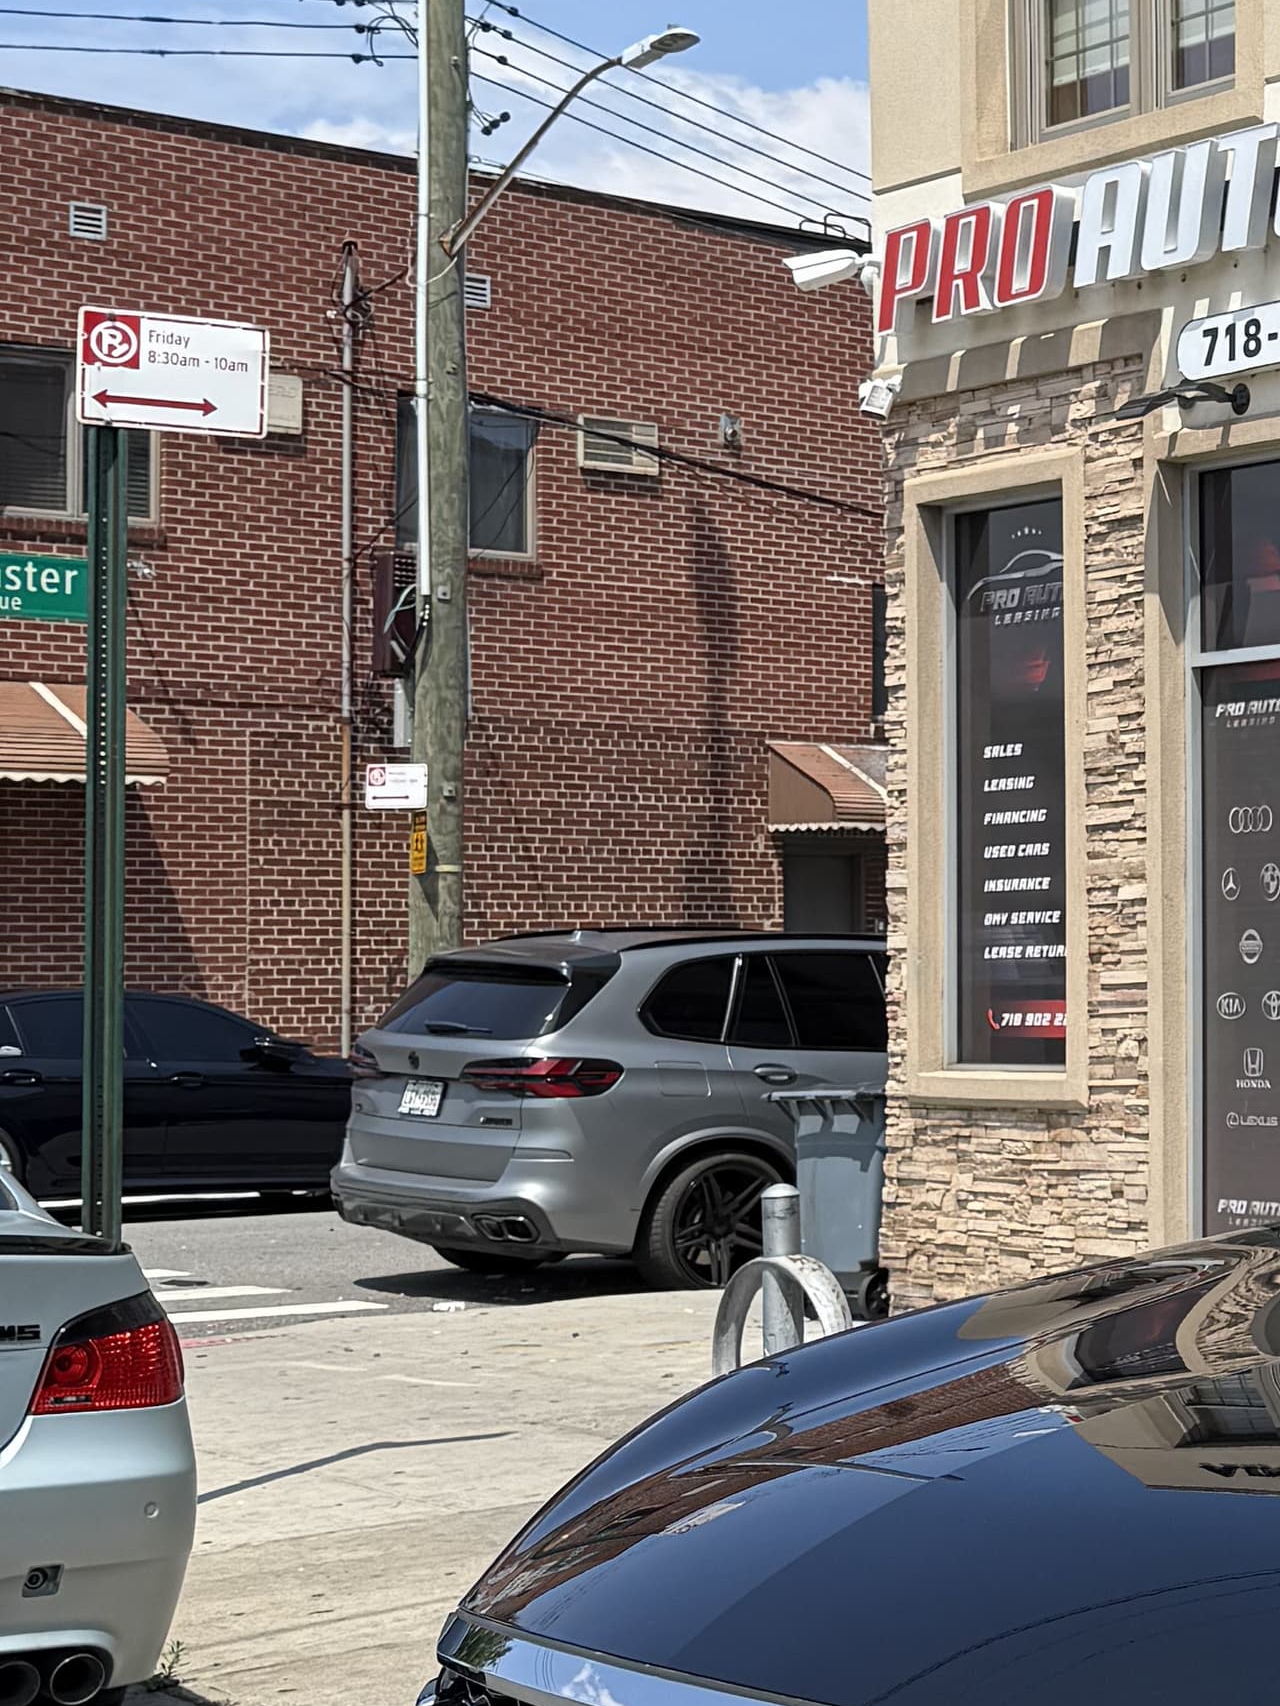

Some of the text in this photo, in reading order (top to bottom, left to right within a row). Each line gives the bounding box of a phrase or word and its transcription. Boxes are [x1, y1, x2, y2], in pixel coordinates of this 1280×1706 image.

[877, 184, 1075, 334] PRO
[148, 329, 191, 350] Friday
[147, 350, 200, 369] 8:30am
[214, 356, 249, 374] 10am
[0, 561, 79, 595] ster
[980, 581, 1064, 613] PRO AUT
[1215, 700, 1246, 718] PRO
[983, 743, 1023, 759] SALES
[983, 775, 1035, 792] LEASING
[983, 808, 1048, 826] FINANCING
[983, 842, 1050, 859] USED CARS
[983, 876, 1051, 893] INSURANCE
[983, 910, 1061, 926] DMV SERVICE
[983, 946, 1024, 960] LEASE
[1220, 997, 1242, 1015] KIA
[1000, 1012, 1023, 1027] 718
[1025, 1012, 1052, 1027] 902
[1236, 1079, 1272, 1089] HONDA
[1240, 1115, 1278, 1127] LEXUS
[1217, 1198, 1248, 1214] PRO
